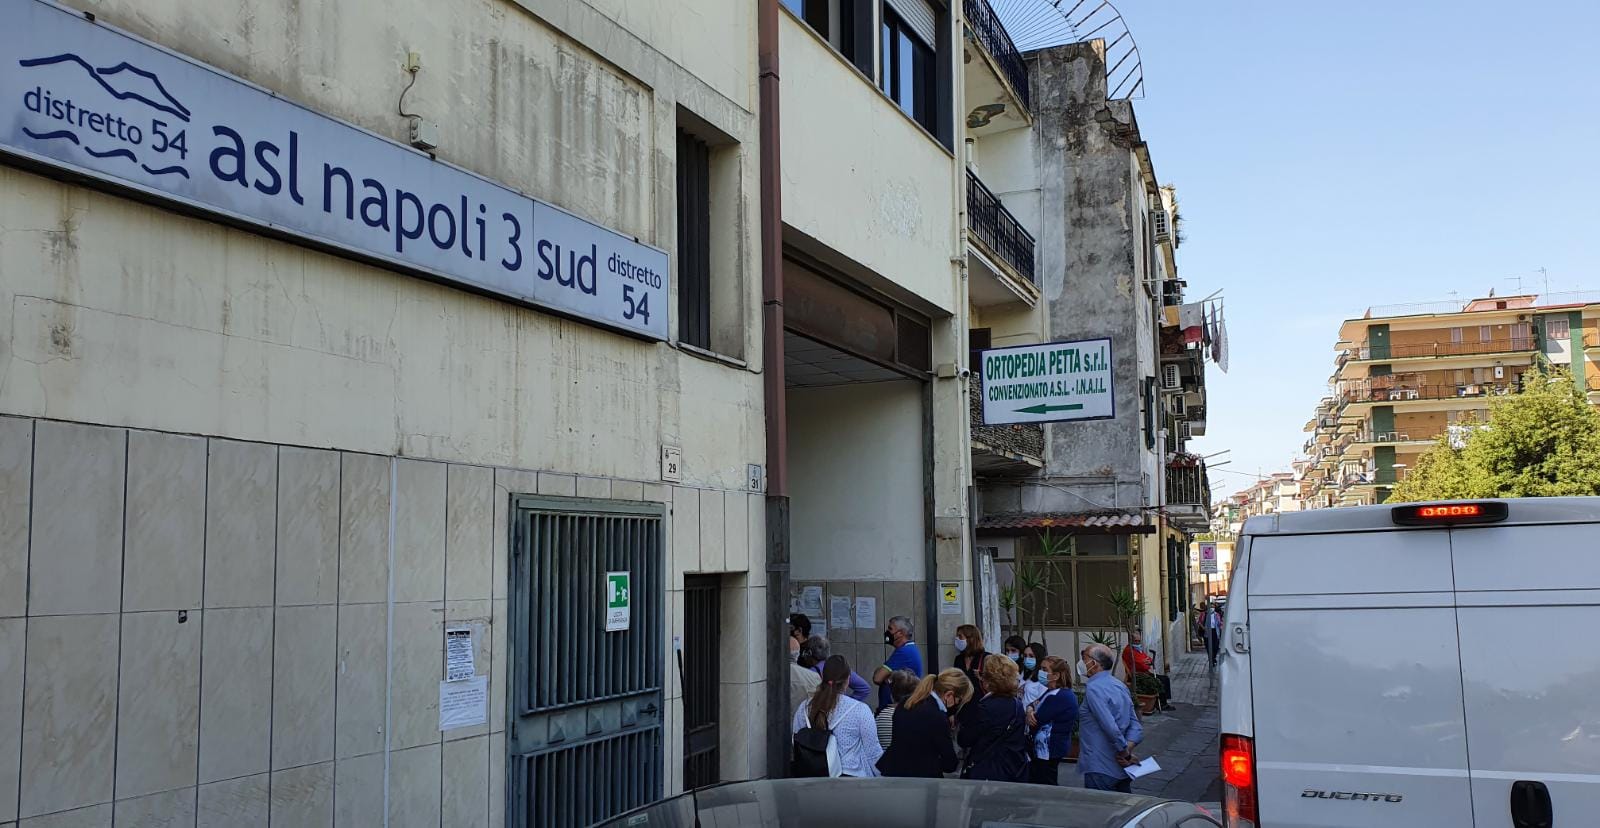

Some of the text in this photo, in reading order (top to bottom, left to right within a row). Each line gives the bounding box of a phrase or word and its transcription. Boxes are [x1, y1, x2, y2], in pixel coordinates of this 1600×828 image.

[24, 86, 188, 159] distretto 54
[209, 125, 597, 296] asl napoli 3 sud
[607, 252, 662, 290] distretto
[622, 285, 650, 325] 54
[986, 346, 1108, 381] ORTOPEDIA PETTA s.r.l.
[988, 381, 1049, 401] CONVENZIONATO
[668, 463, 676, 473] 29
[751, 478, 759, 489] 31
[1301, 789, 1403, 803] DUCATO
